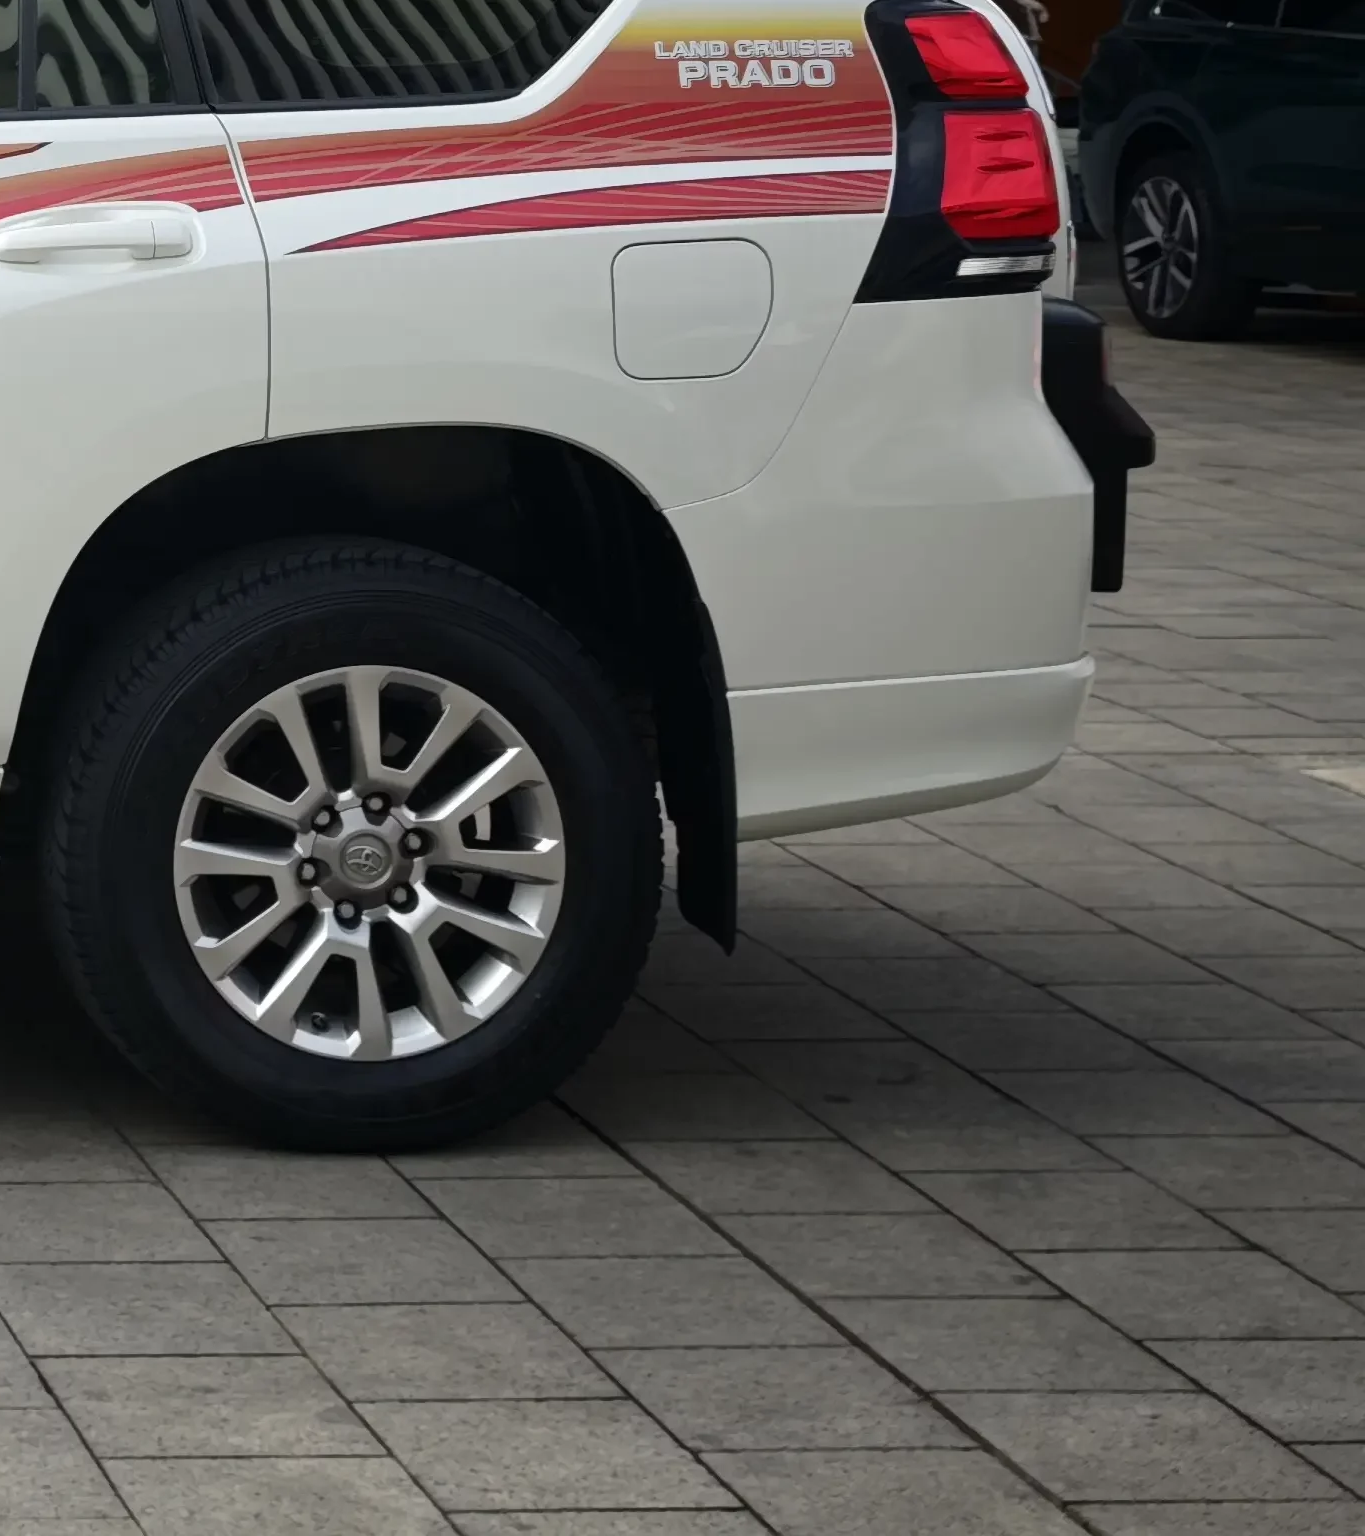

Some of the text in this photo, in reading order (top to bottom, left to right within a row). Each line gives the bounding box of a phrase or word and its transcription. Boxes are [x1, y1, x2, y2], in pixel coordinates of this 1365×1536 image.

[653, 39, 855, 60] LAND CRUISER
[677, 59, 836, 89] PRADO
